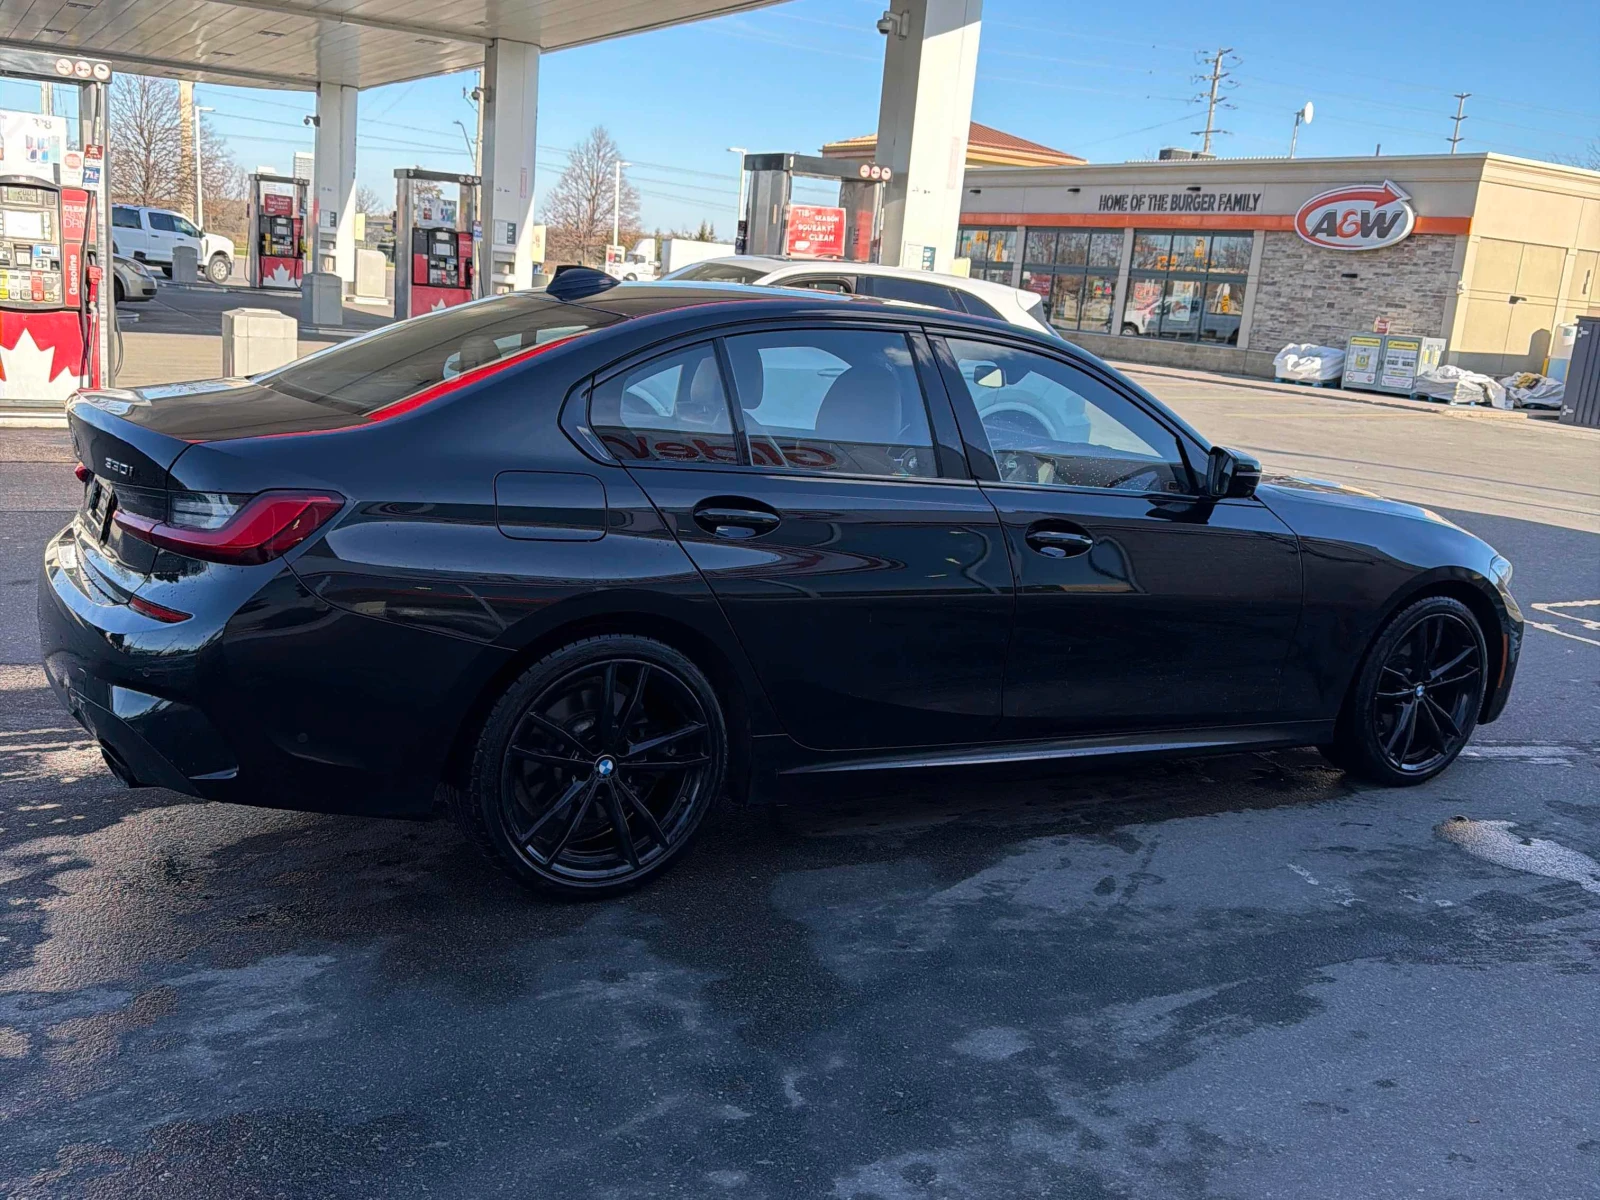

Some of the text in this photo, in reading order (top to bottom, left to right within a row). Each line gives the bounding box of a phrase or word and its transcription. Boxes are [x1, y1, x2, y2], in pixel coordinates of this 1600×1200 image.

[1098, 193, 1261, 212] HOME OF THE BURGER FAMILY
[1309, 208, 1404, 239] A&W
[809, 234, 834, 242] CLEAN
[68, 254, 77, 295] Gasoline
[105, 457, 134, 477] 330i
